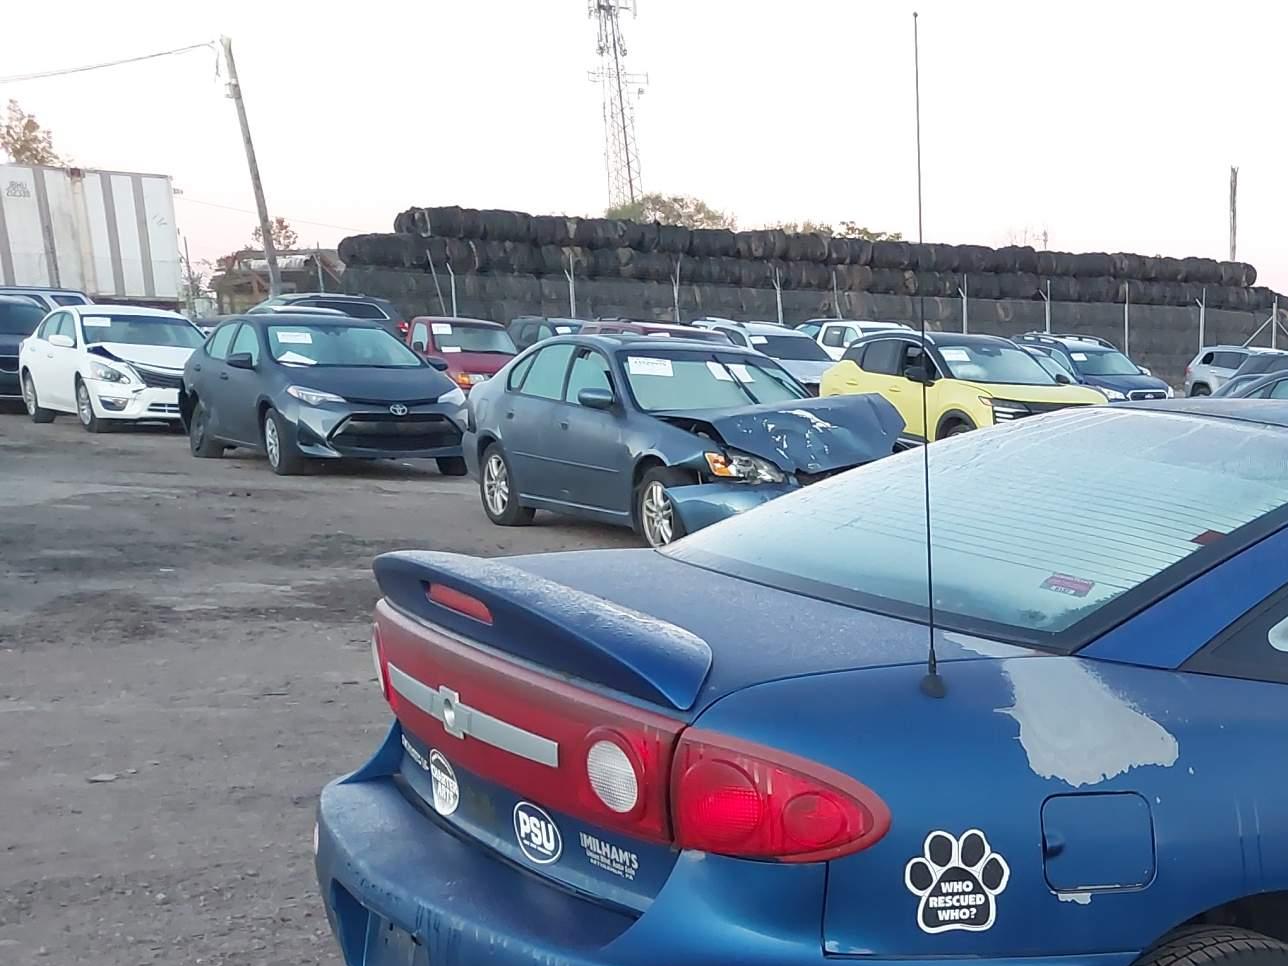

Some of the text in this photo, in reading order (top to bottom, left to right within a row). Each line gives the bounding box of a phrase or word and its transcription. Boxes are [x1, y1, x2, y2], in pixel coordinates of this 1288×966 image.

[518, 810, 555, 851] PSU
[940, 880, 974, 893] WHO
[928, 893, 985, 908] RESCUED
[937, 907, 977, 921] WHO?
